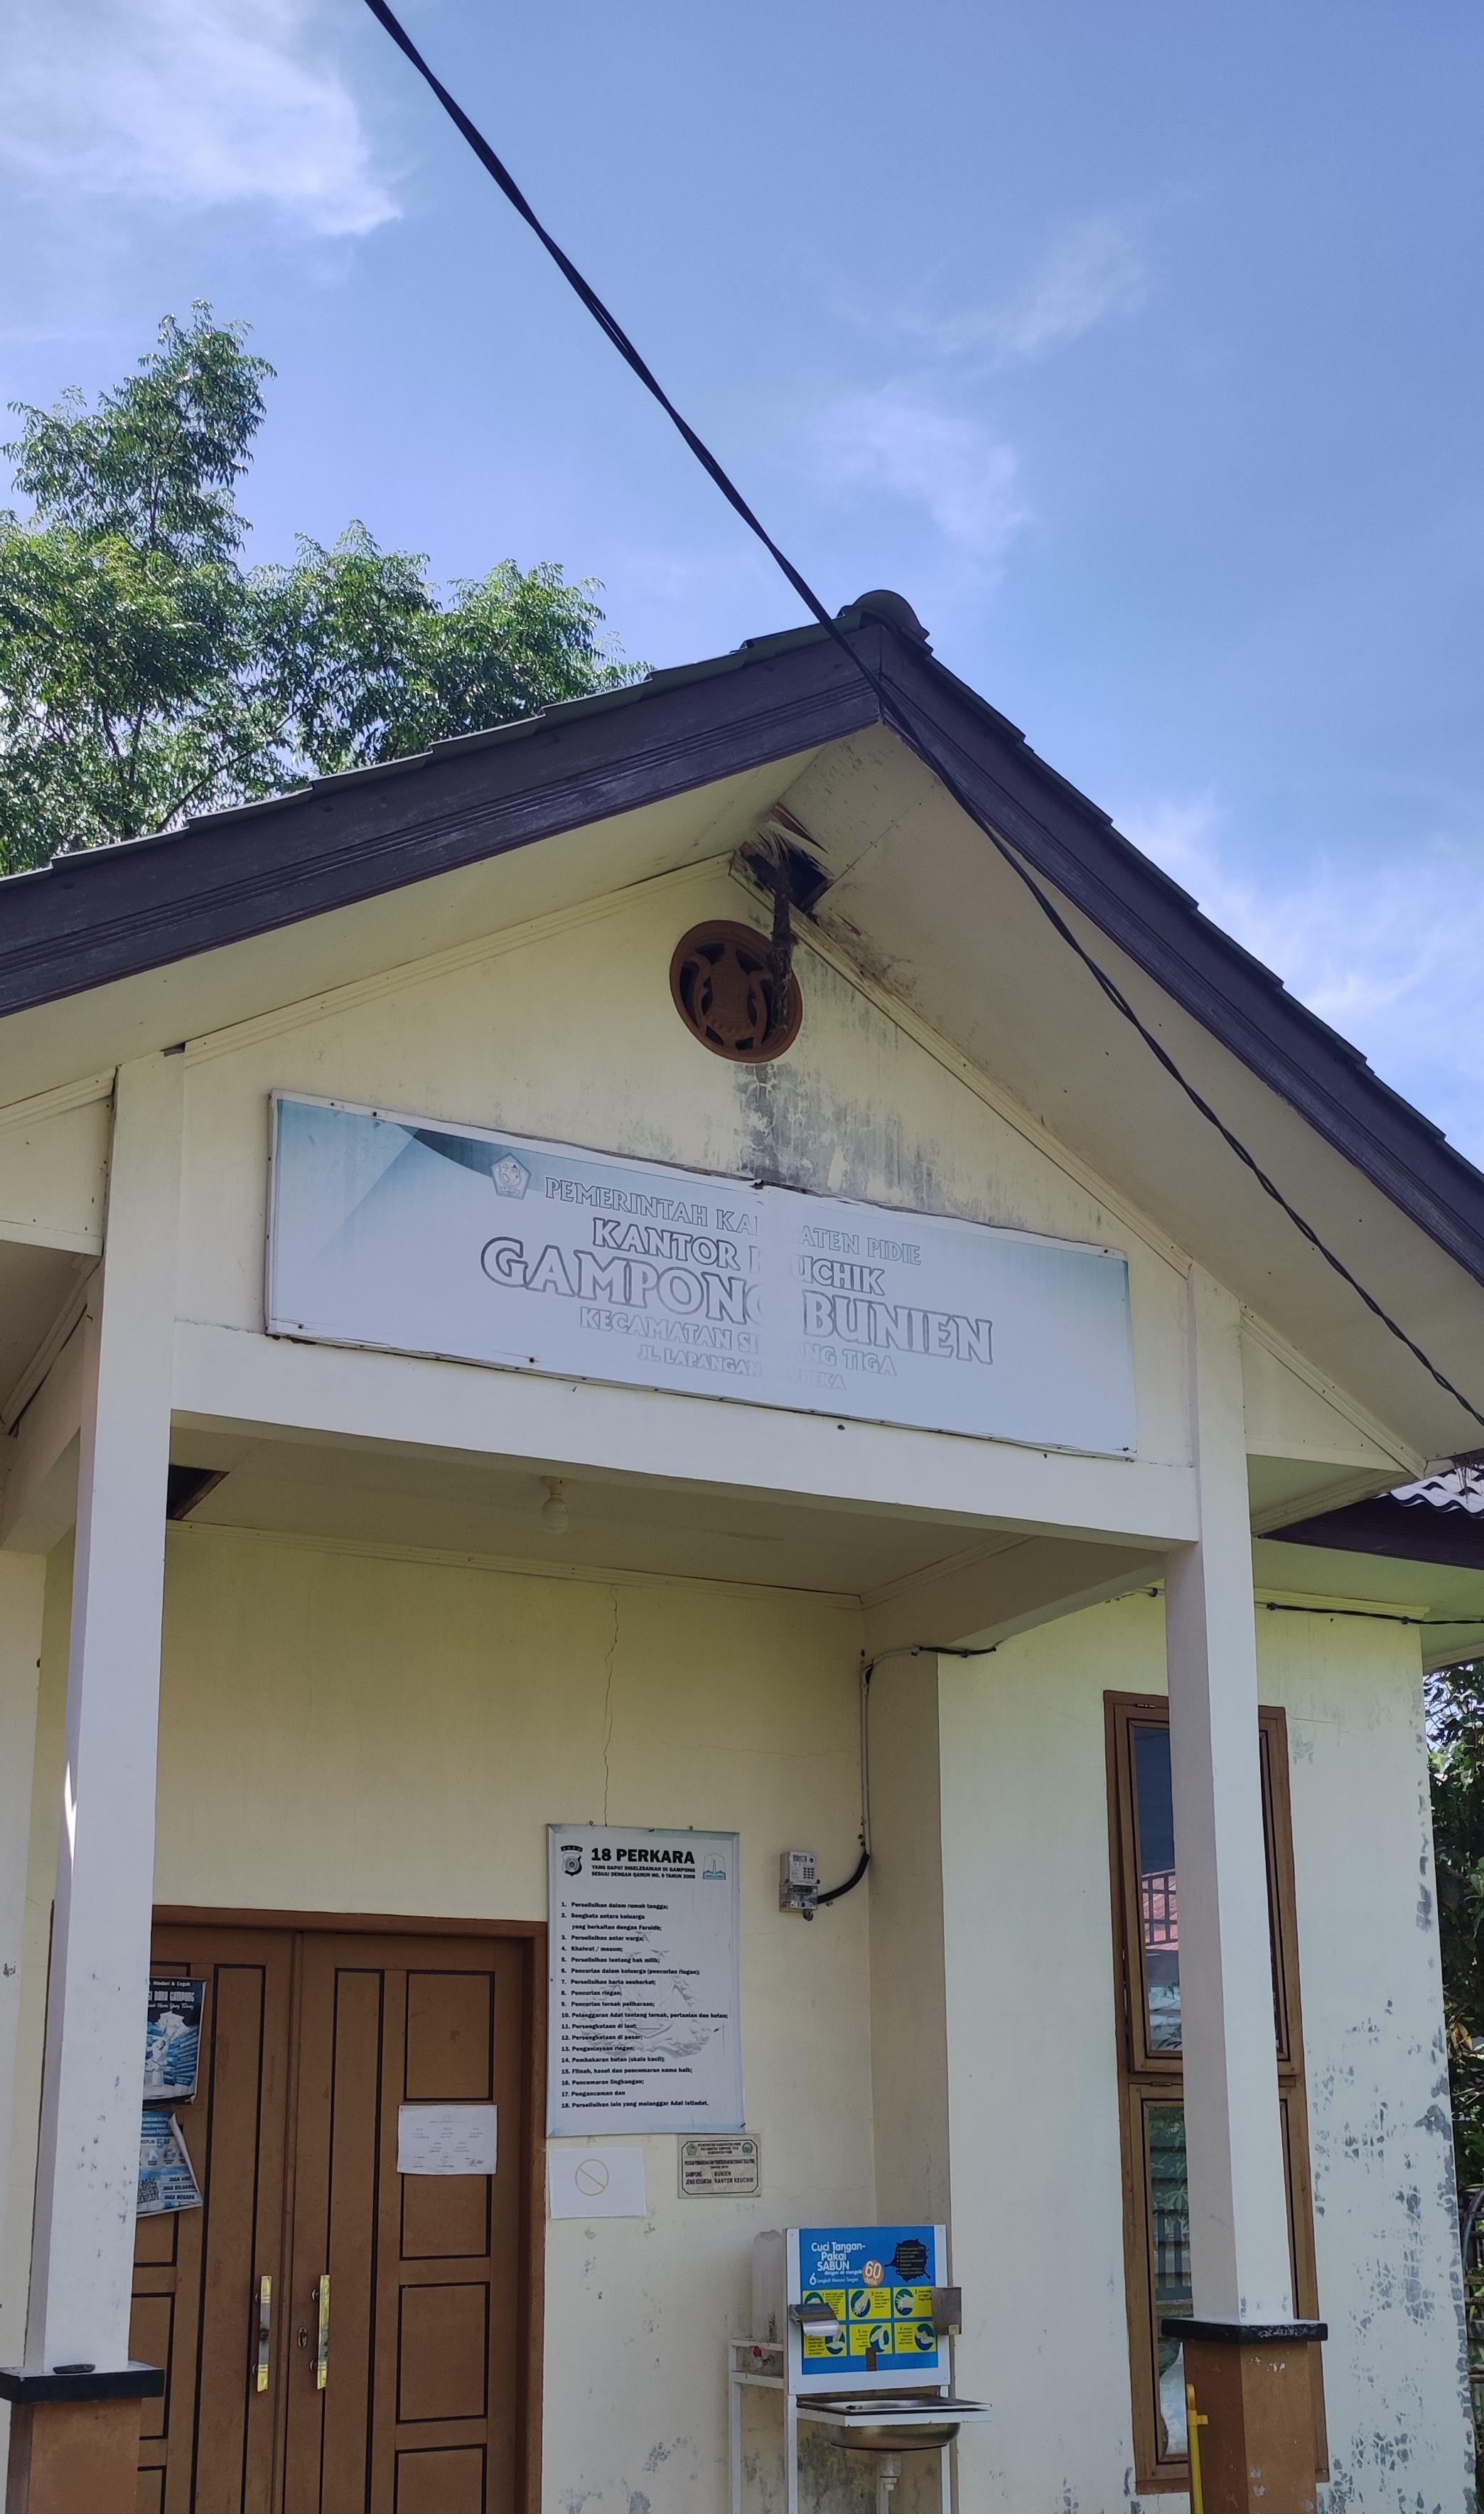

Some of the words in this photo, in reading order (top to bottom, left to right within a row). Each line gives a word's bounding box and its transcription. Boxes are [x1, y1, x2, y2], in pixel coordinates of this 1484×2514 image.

[545, 1177, 709, 1228] PEMERINTAH
[866, 1237, 922, 1265] PIDIE
[593, 1217, 741, 1271] KANTOR
[802, 1289, 994, 1365] BUNIEN
[580, 1306, 733, 1351] KECAMATAN
[842, 1348, 898, 1377] TIGA
[638, 1344, 662, 1363] JL.
[664, 1348, 762, 1379] LAPANGAN
[591, 1848, 611, 1861] 18
[616, 1849, 695, 1864] PERKARA
[811, 2242, 829, 2252] Cuci
[822, 2252, 846, 2261] Pakai
[817, 2260, 849, 2272] SABUN
[865, 2261, 881, 2278] 60
[810, 2272, 816, 2285] 6
[864, 2277, 878, 2286] detik
